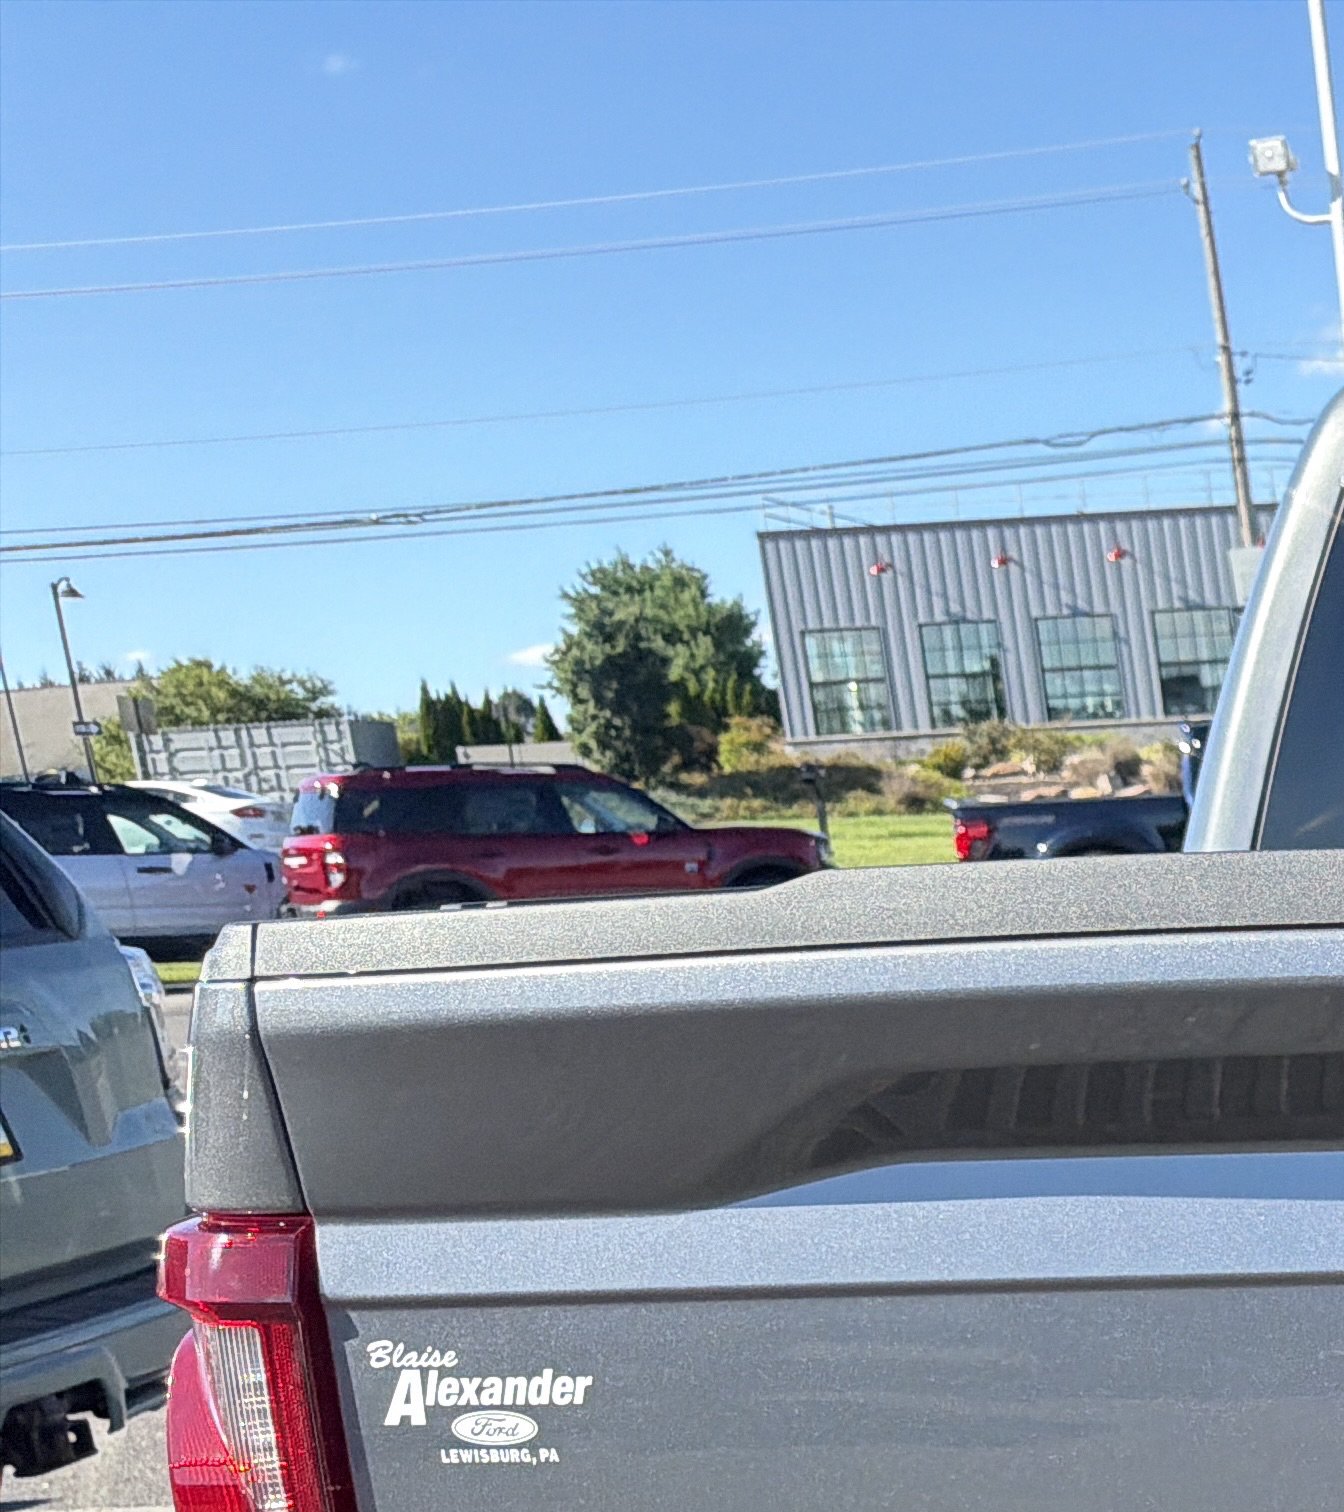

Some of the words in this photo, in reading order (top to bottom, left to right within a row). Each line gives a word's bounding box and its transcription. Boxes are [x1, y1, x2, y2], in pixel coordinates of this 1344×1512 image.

[366, 1339, 459, 1369] Blaise
[383, 1367, 594, 1427] Alexander
[470, 1416, 521, 1438] Ford
[440, 1447, 537, 1466] LEWISBURG,
[539, 1447, 561, 1464] PA
